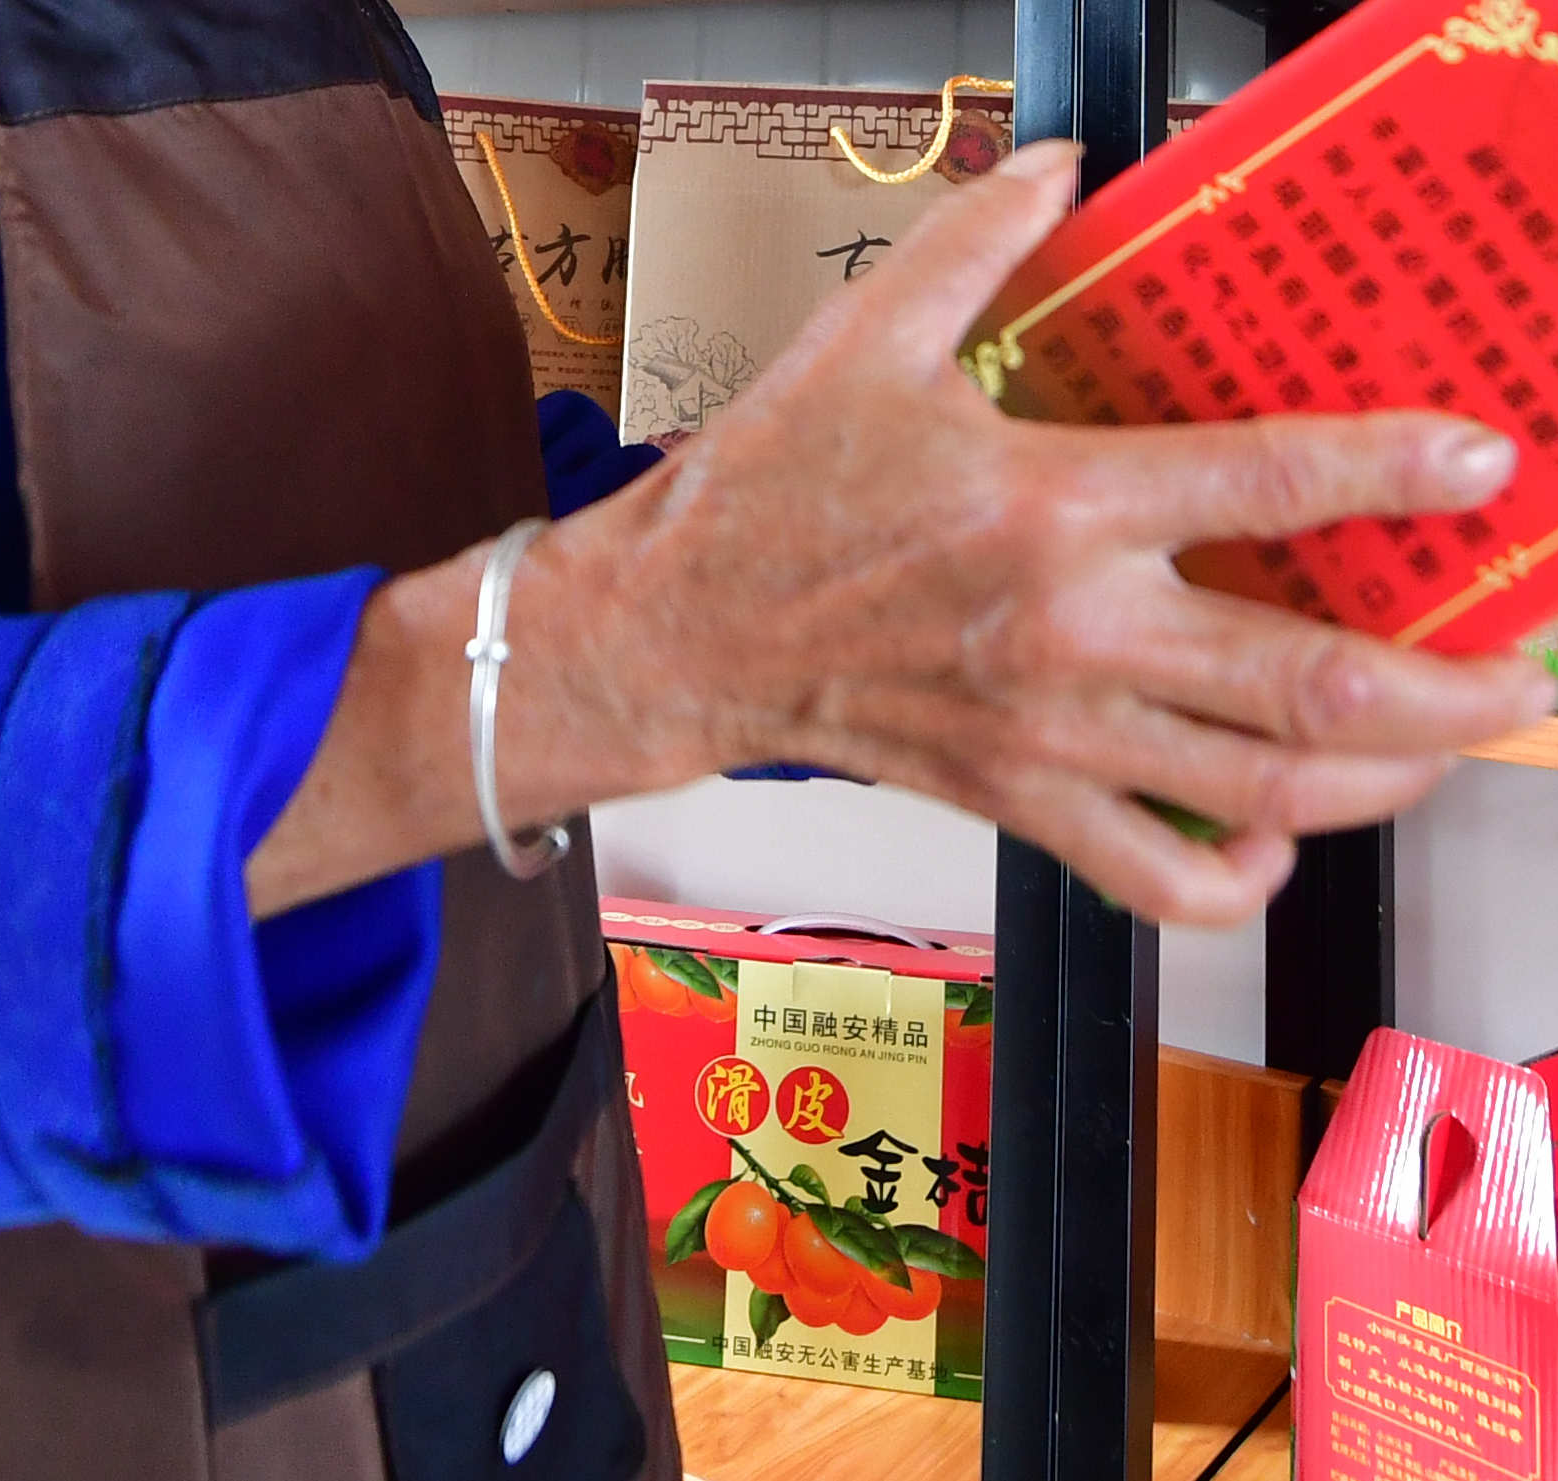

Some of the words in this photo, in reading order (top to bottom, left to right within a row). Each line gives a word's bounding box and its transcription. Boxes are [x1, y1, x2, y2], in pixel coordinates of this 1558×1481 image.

[750, 1036, 791, 1052] ZHONG
[793, 1039, 820, 1054] GUO
[822, 1042, 858, 1059] RONG
[859, 1048, 876, 1061] AN
[877, 1049, 905, 1064] JING
[907, 1053, 928, 1066] PIN
[752, 1003, 929, 1049] 中国融安精品
[705, 1056, 846, 1141] 滑皮
[837, 1128, 990, 1228] 金桔
[710, 1333, 951, 1386] 中国融安无公害生产基地
